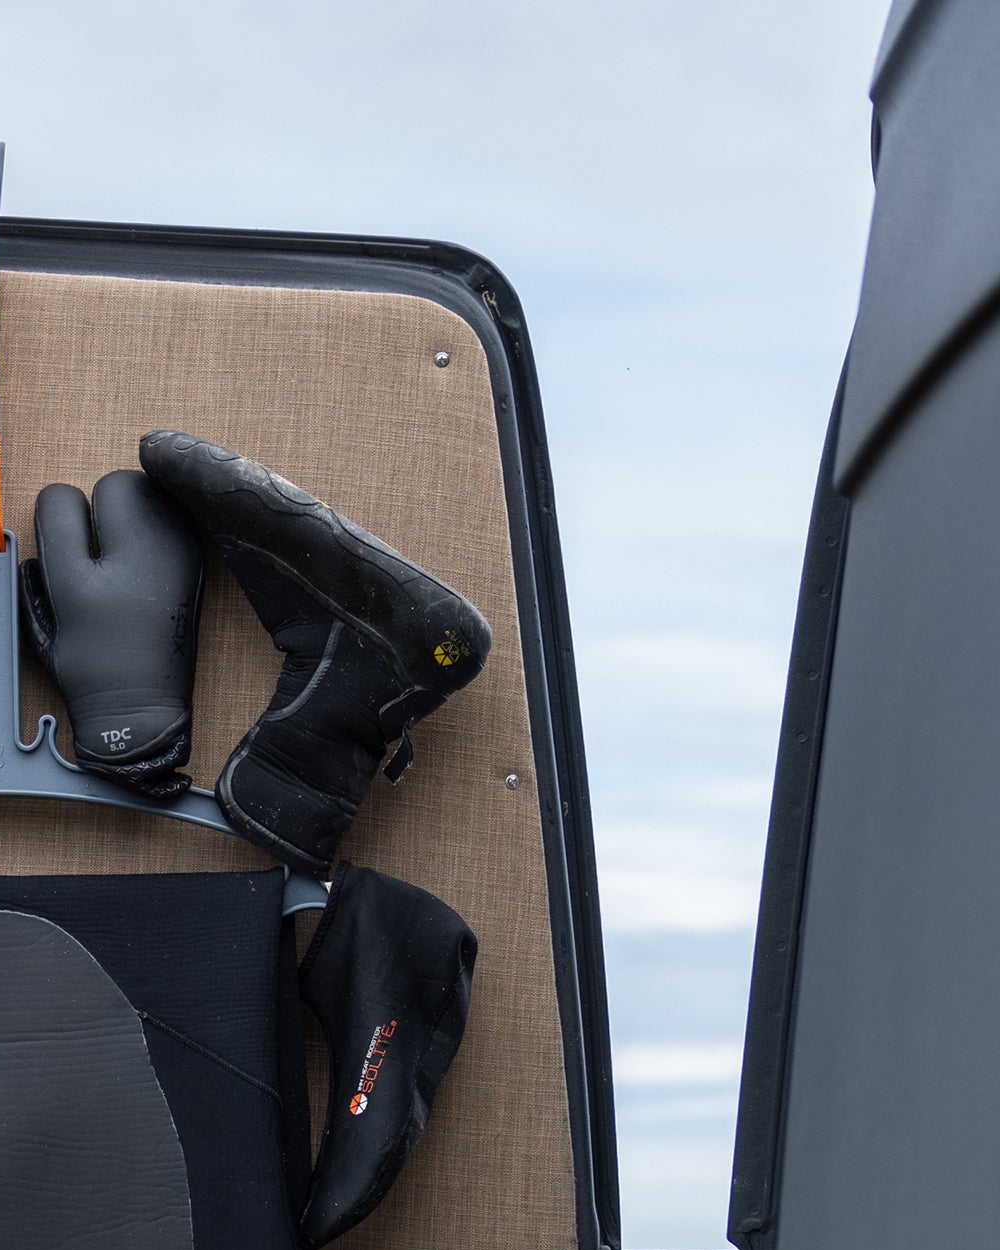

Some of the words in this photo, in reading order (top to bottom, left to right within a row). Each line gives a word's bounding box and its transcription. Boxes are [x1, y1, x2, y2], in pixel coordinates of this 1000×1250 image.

[100, 727, 132, 744] TDC
[110, 742, 126, 751] 5.0
[362, 1024, 395, 1093] SOLITE
